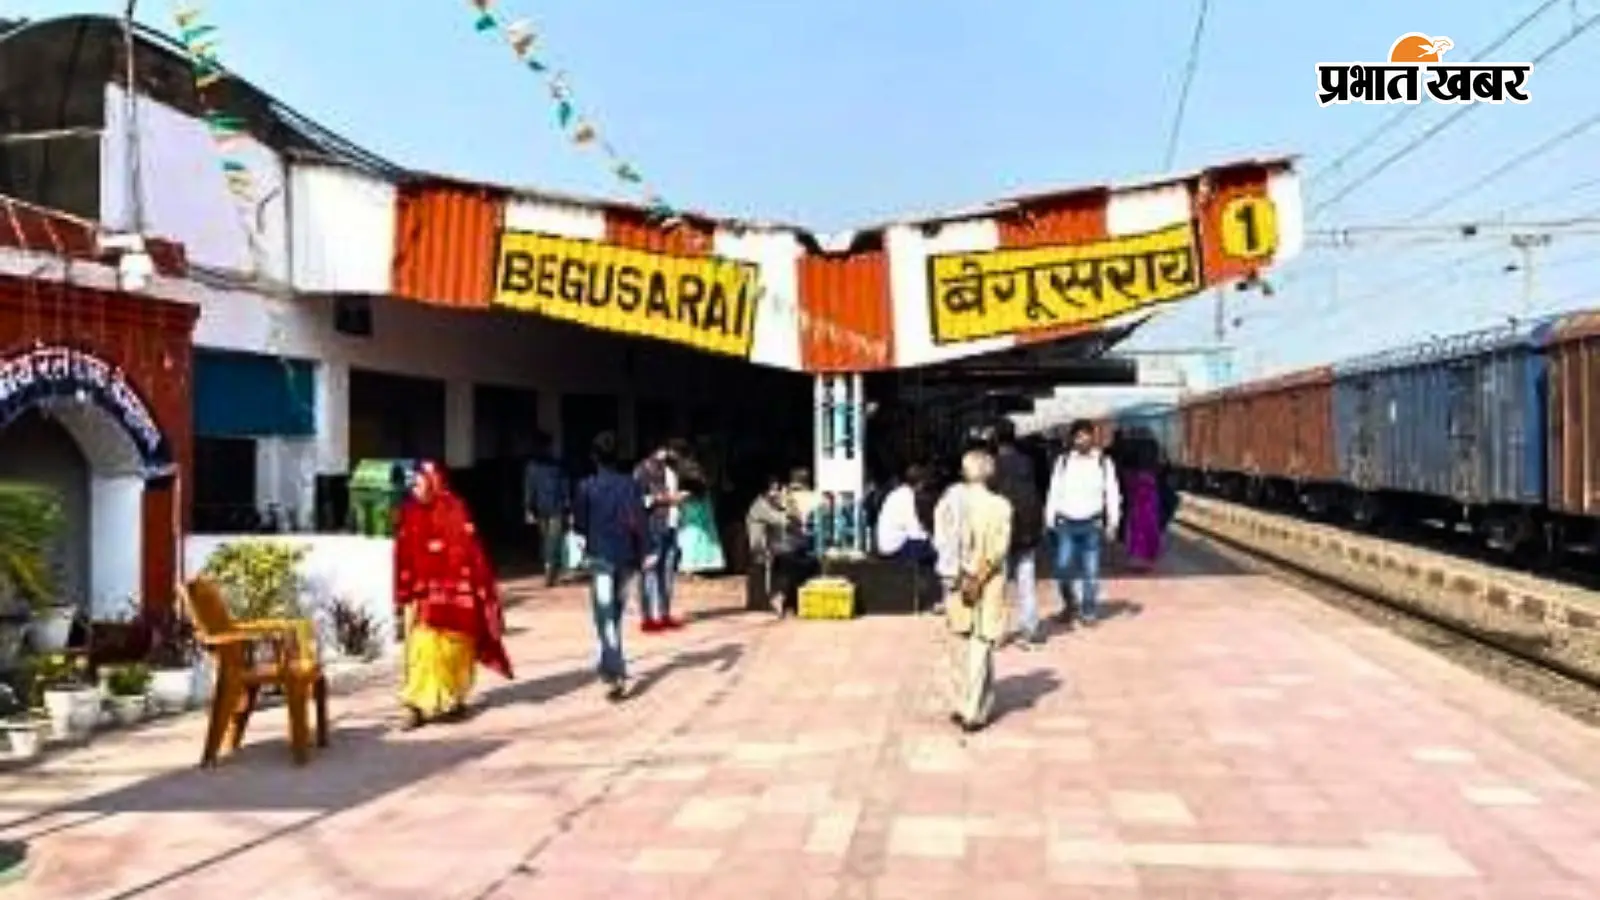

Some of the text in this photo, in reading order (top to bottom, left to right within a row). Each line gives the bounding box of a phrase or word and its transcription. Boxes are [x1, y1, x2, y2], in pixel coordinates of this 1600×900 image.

[1234, 205, 1260, 252] 1
[501, 250, 748, 338] BEGUSARAI
[940, 247, 1192, 320] बेगूसराय
